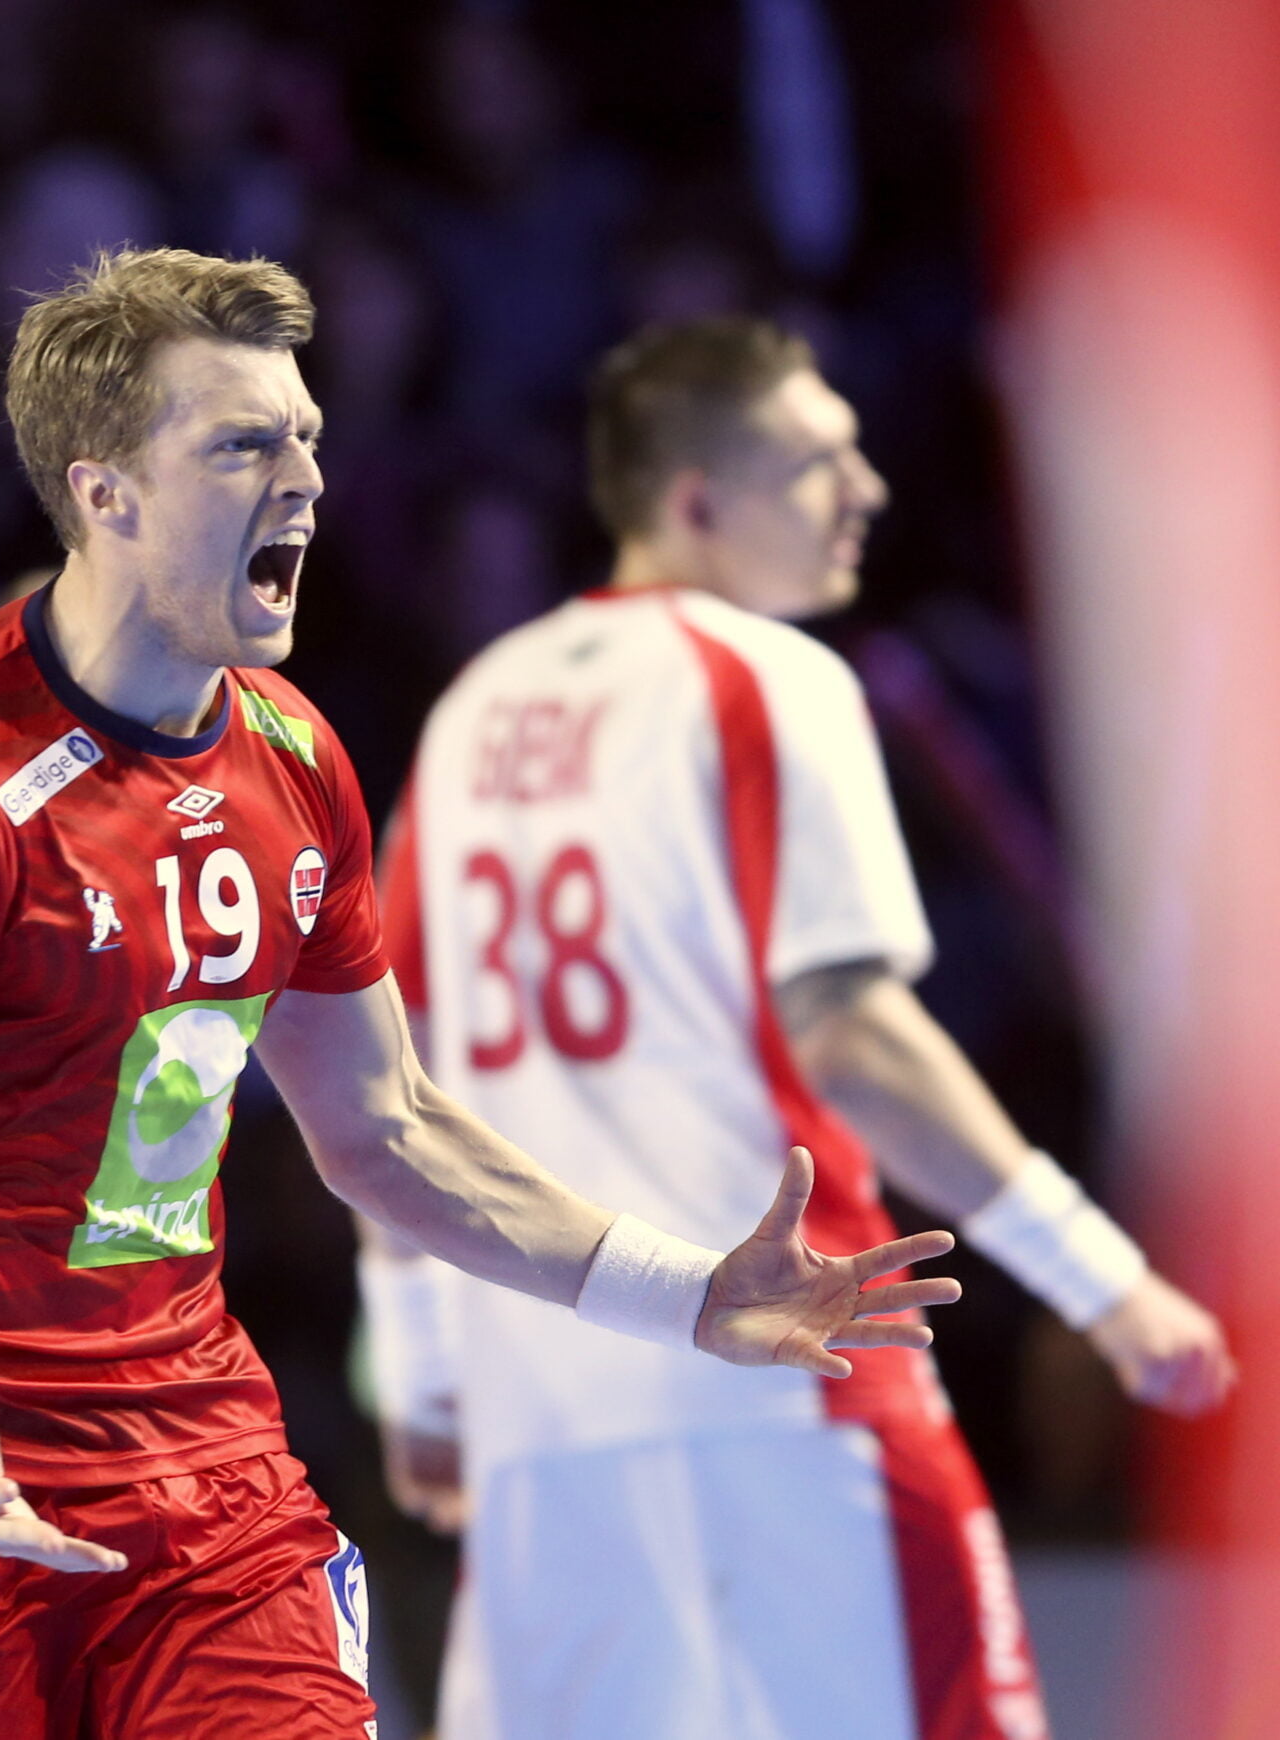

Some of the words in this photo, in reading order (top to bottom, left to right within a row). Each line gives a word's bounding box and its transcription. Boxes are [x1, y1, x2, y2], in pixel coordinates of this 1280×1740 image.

[180, 820, 225, 841] umbro
[155, 847, 261, 993] 19
[464, 846, 629, 1071] 38
